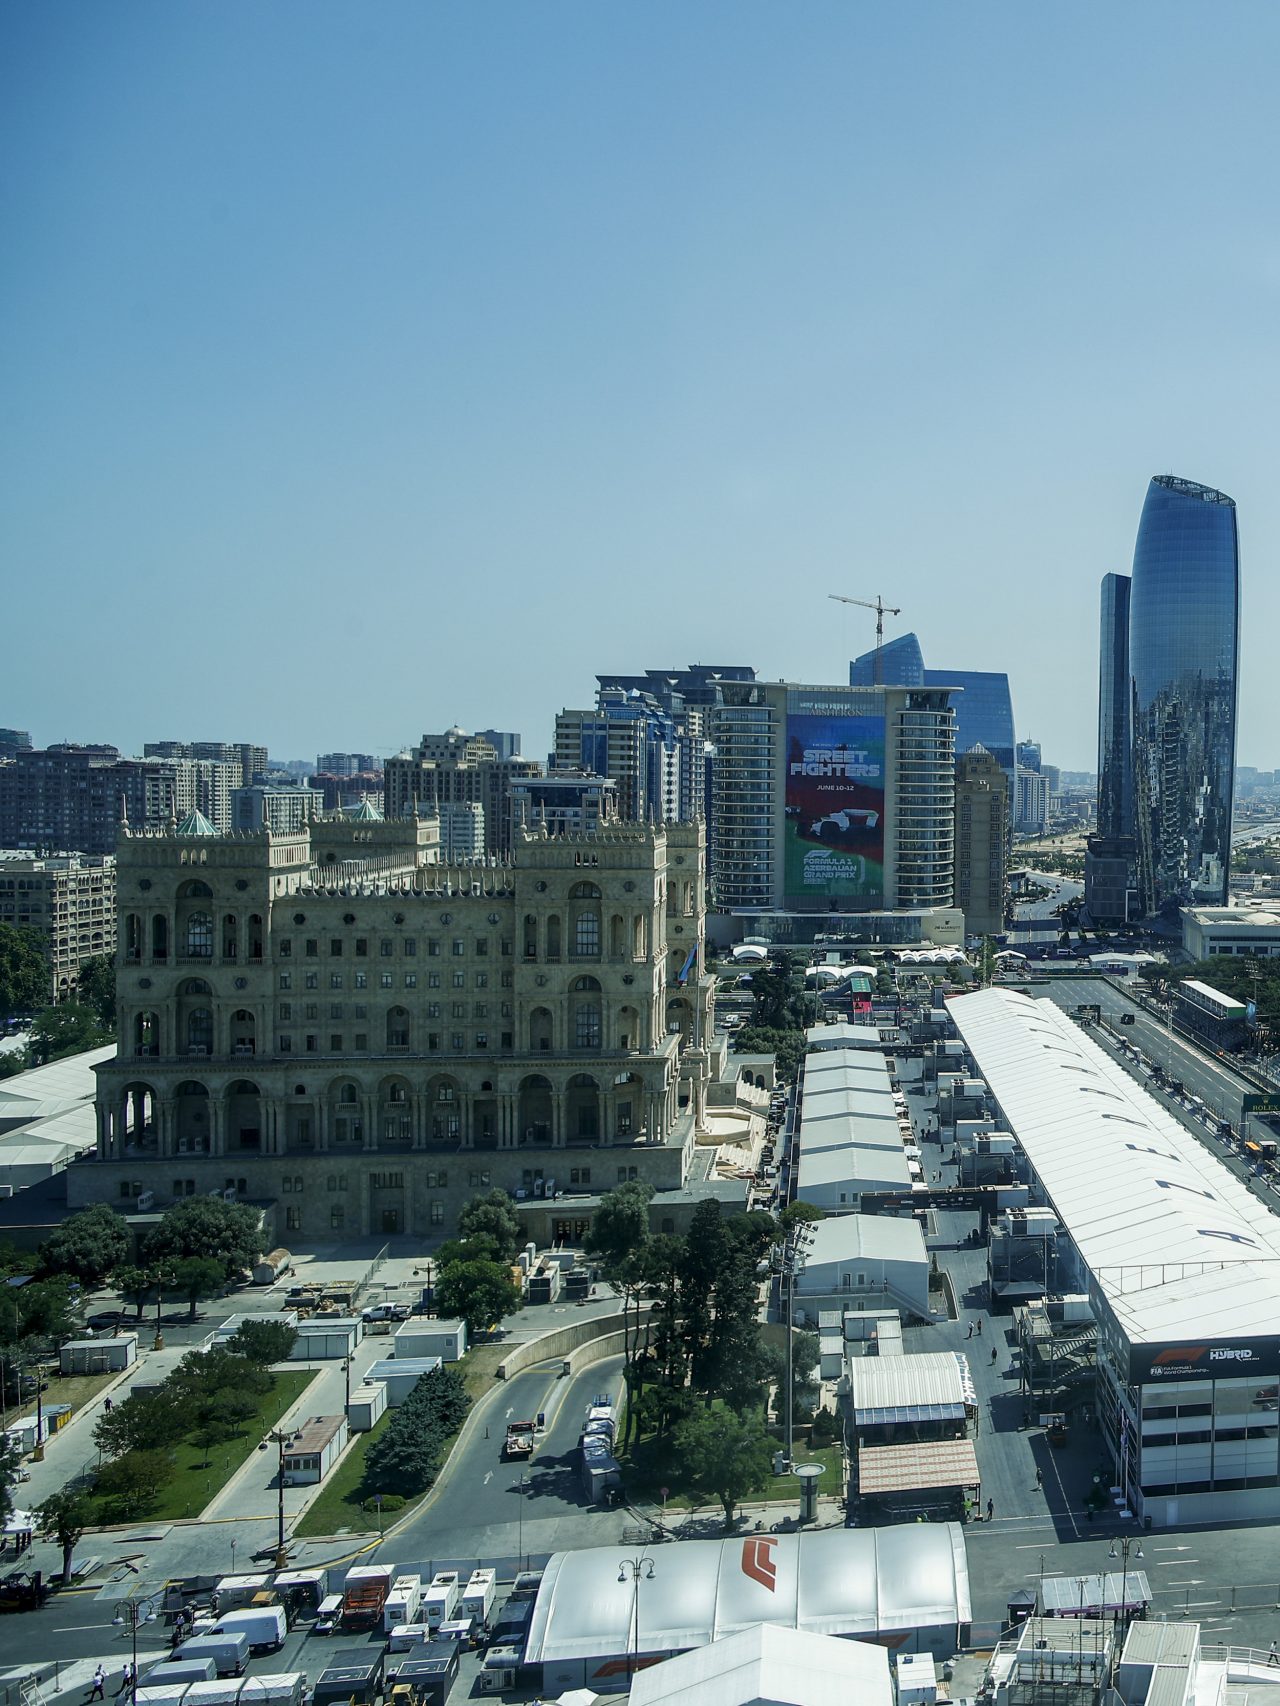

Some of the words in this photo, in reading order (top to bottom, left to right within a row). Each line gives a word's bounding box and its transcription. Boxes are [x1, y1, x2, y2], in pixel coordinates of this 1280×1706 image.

[803, 750, 869, 763] STREET
[790, 763, 880, 777] FIGHTERS
[1209, 1349, 1253, 1361] HYBRID
[1150, 1367, 1163, 1375] FIA
